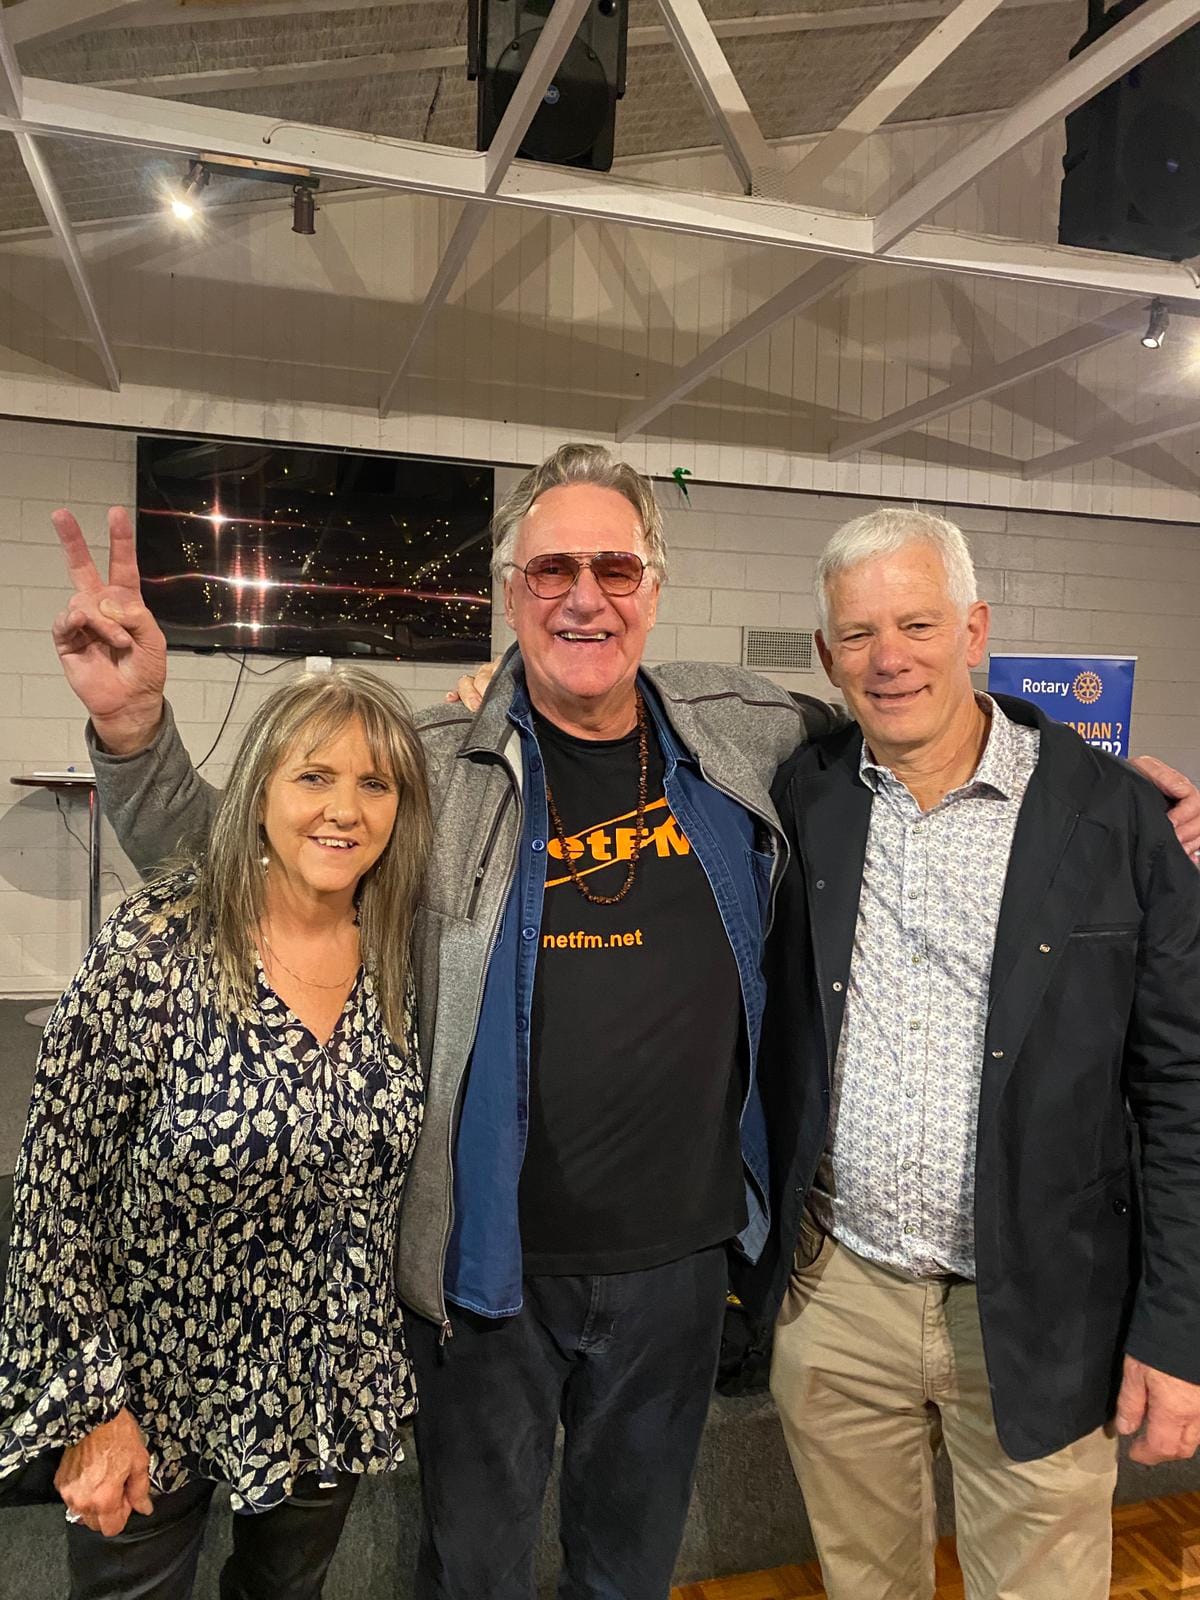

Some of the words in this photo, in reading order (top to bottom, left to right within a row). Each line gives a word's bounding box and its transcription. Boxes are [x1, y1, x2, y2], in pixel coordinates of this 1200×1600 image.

[1022, 678, 1070, 697] Rotary
[1064, 722, 1112, 739] RIAN
[1115, 723, 1122, 739] ?
[543, 929, 642, 948] netfm.net
